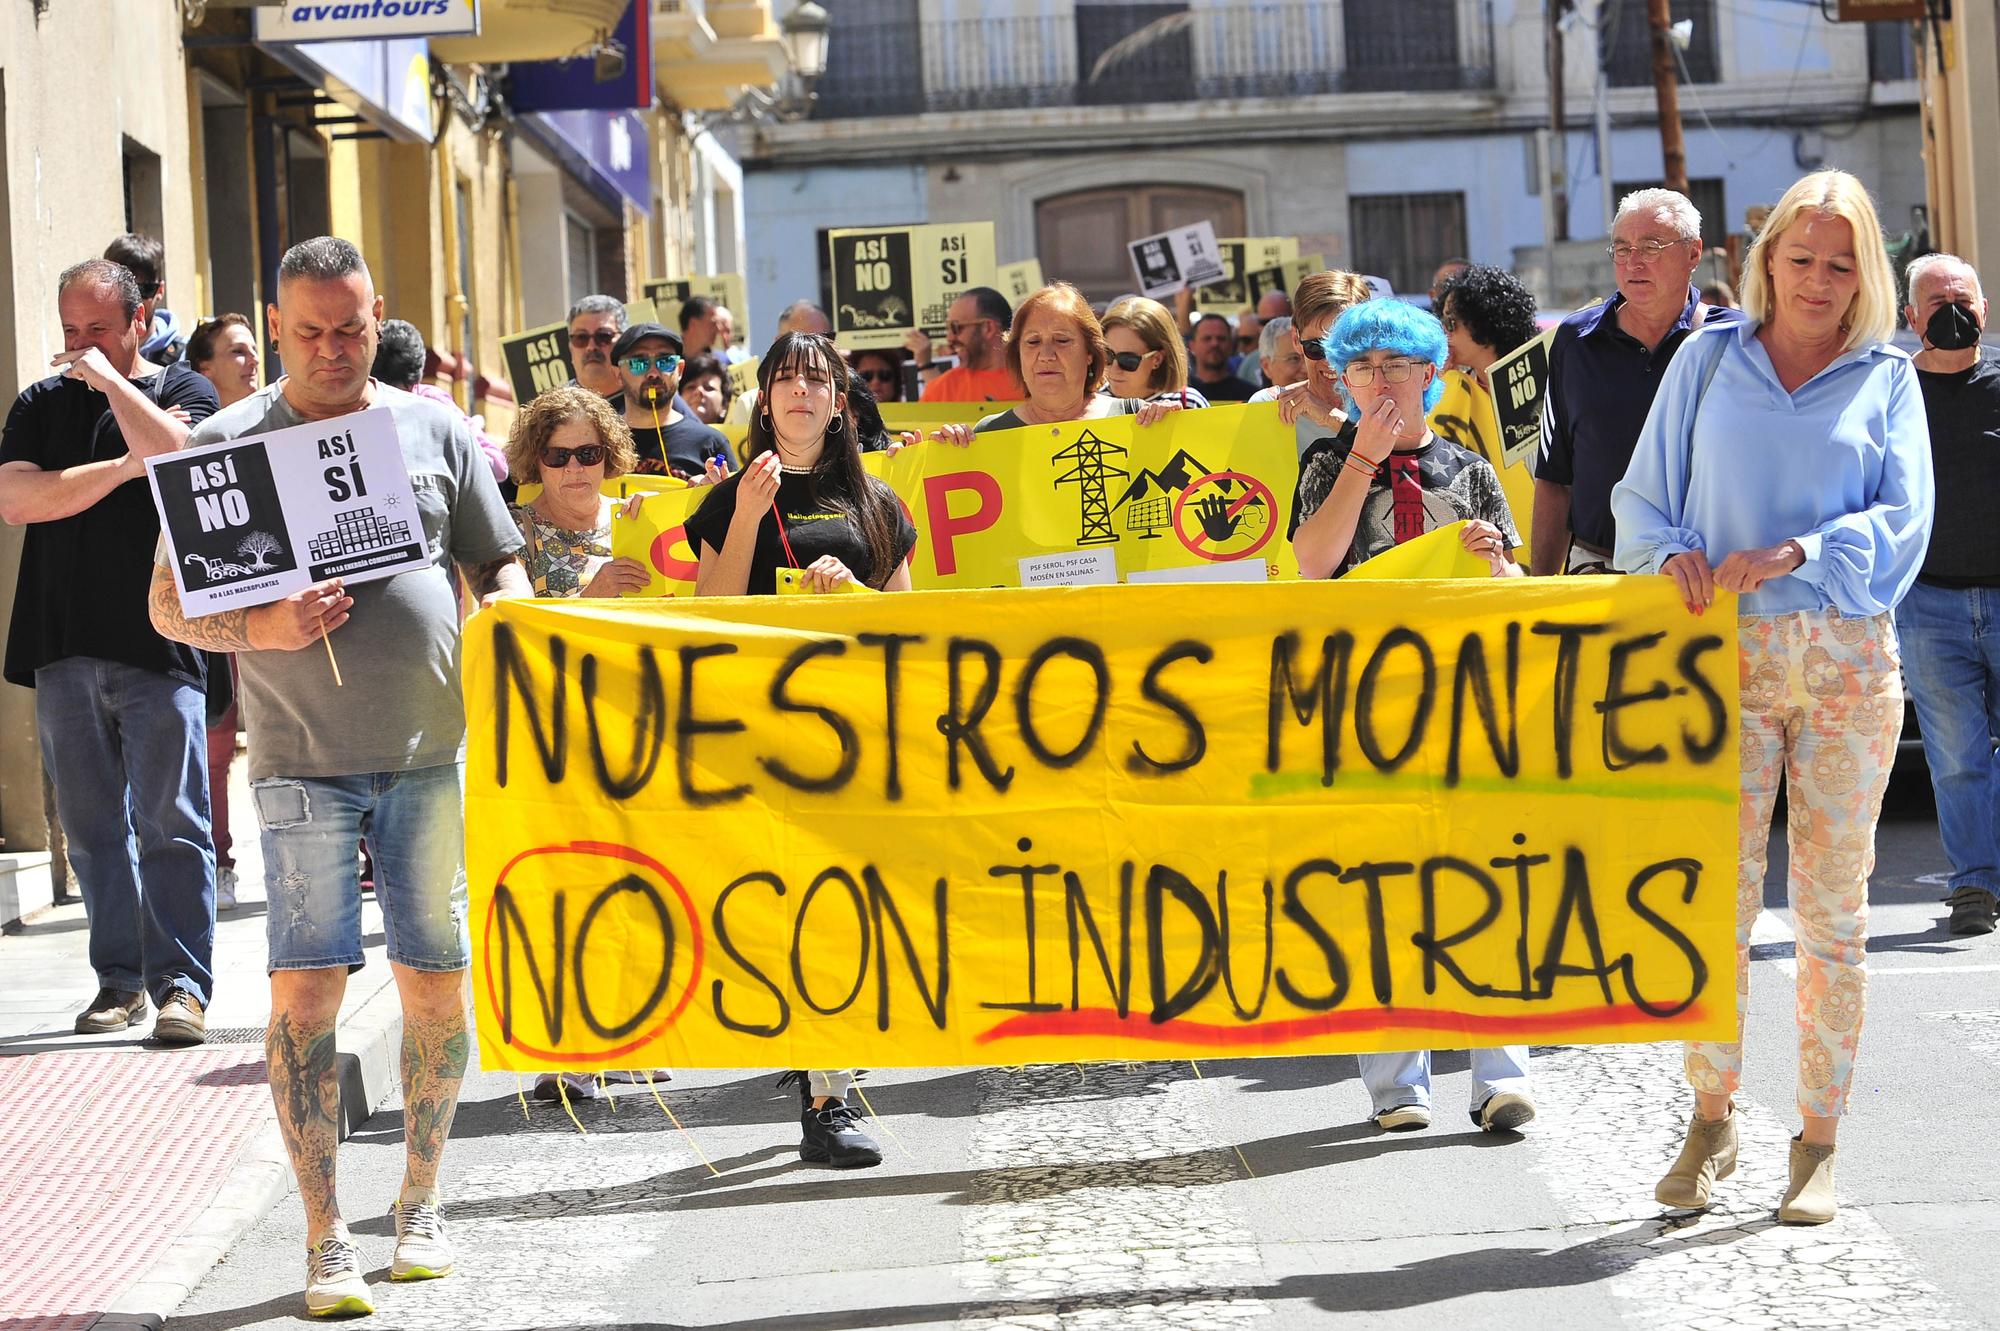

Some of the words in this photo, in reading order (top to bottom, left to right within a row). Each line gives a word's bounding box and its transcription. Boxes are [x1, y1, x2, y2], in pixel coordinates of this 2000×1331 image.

[292, 0, 448, 22] avantours
[854, 236, 888, 261] ASÍ
[941, 233, 966, 252] ASÍ
[855, 262, 891, 292] NO
[941, 253, 968, 284] SÍ
[526, 333, 560, 363] ASÍ
[530, 359, 569, 394] NO
[1508, 353, 1531, 384] ASÍ
[1510, 375, 1537, 410] NO
[317, 429, 356, 460] ASÍ
[190, 454, 238, 492] ASÍ
[324, 455, 368, 502] SÍ
[194, 488, 250, 533] NO
[1030, 564, 1042, 572] PSF
[1042, 561, 1065, 570] SEROL,
[1066, 559, 1078, 567] PSF
[1079, 557, 1097, 565] CASA
[1030, 573, 1054, 582] MOSÉN
[1055, 571, 1065, 579] EN
[1066, 567, 1094, 577] SALINAS
[234, 580, 280, 594] MACROPLANTAS
[493, 620, 1213, 806] NUESTROS
[1267, 621, 1729, 787] MONTES
[495, 872, 676, 1046] NO
[712, 865, 947, 1038] SON
[979, 834, 1708, 1024] INDUSTRIAS
